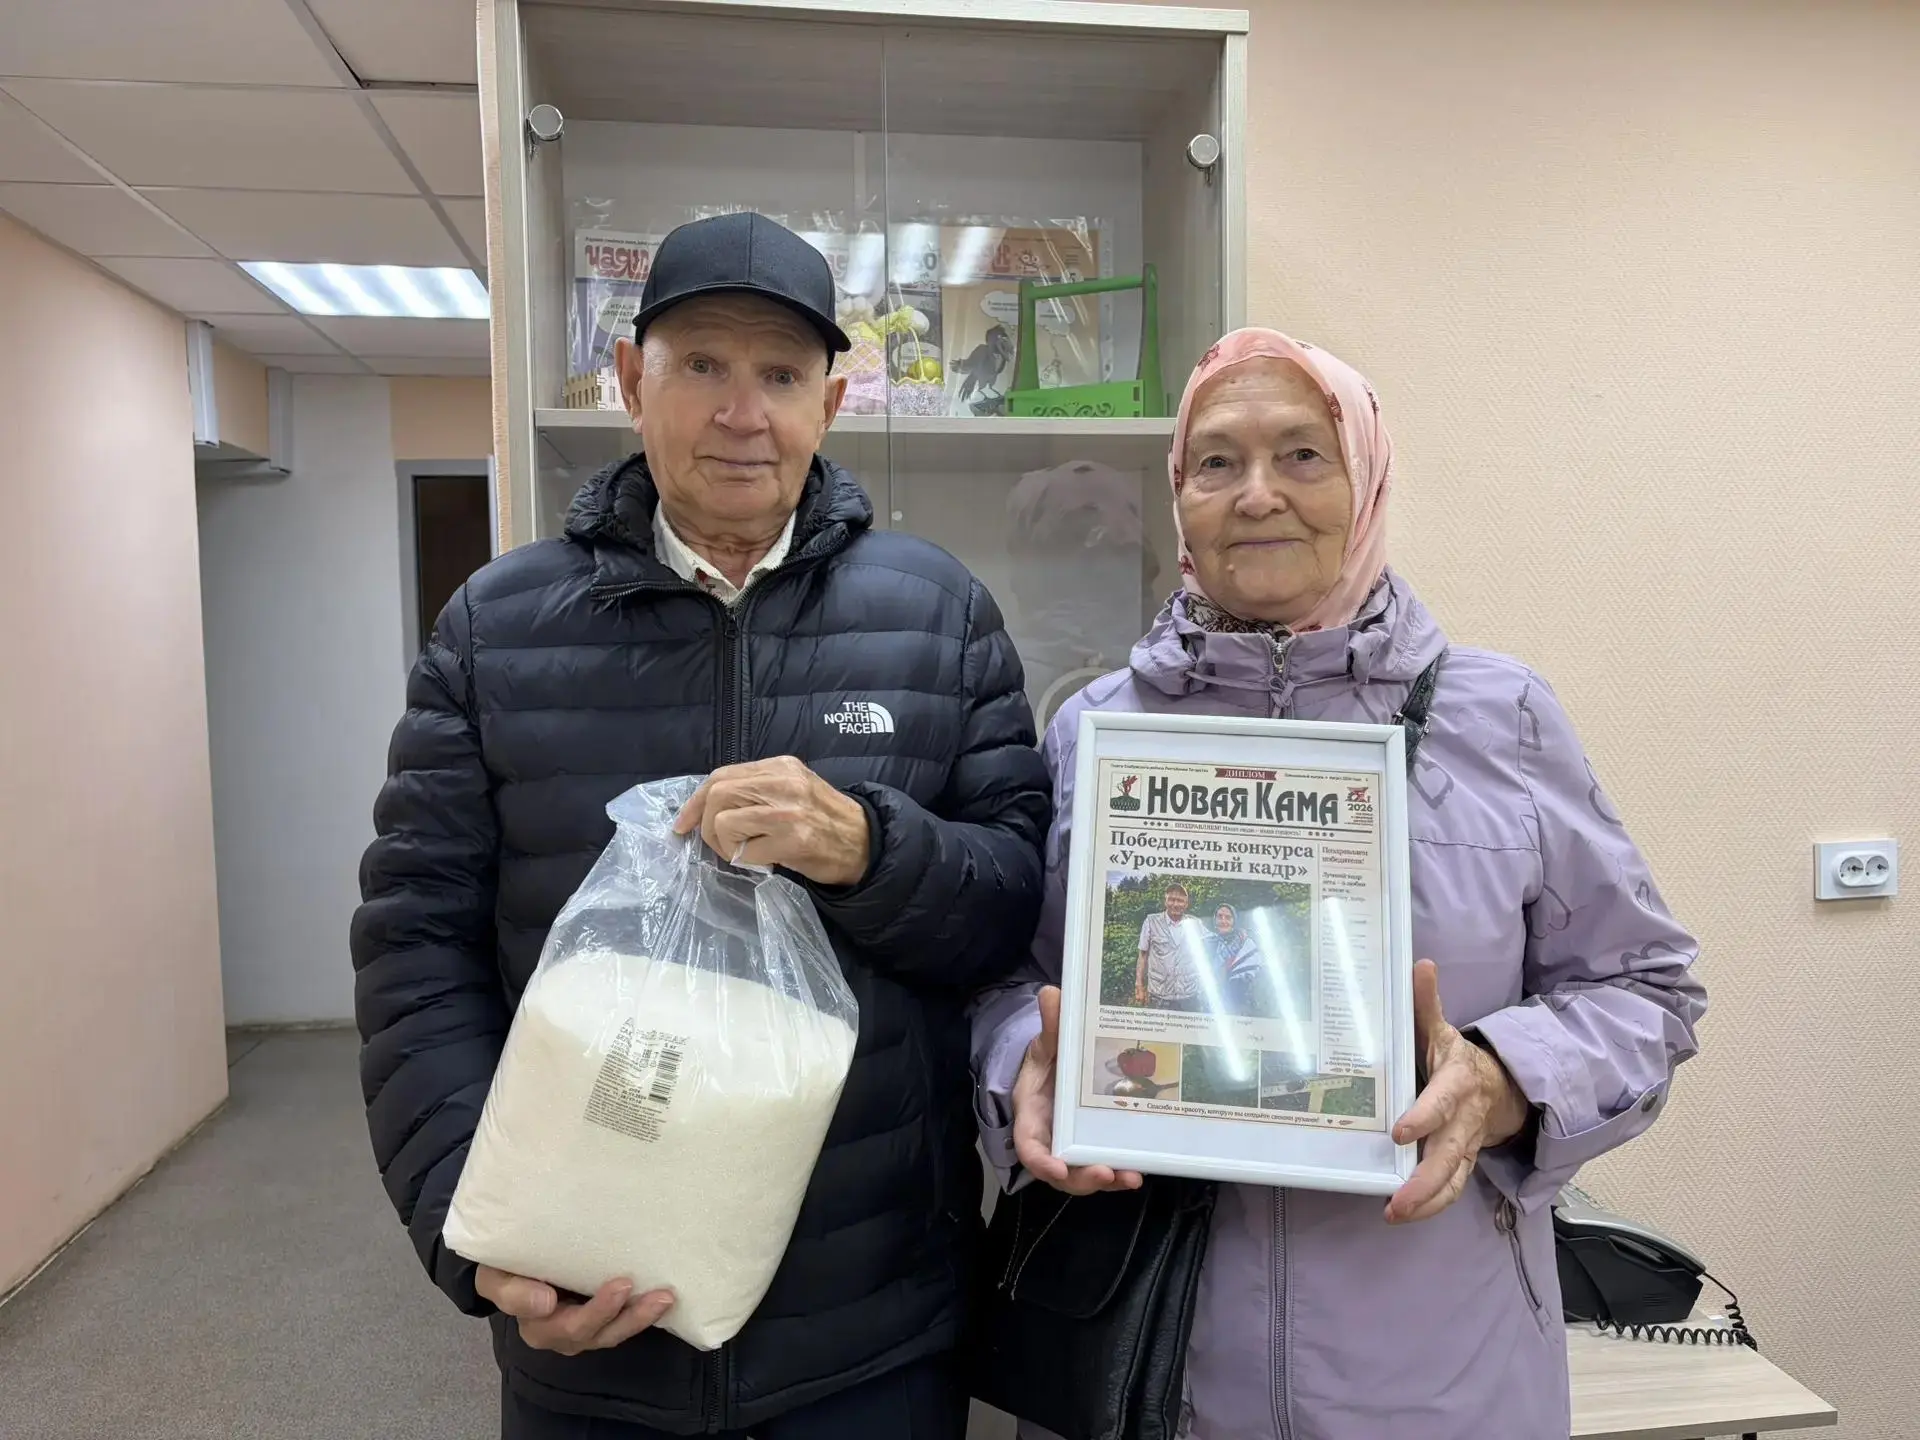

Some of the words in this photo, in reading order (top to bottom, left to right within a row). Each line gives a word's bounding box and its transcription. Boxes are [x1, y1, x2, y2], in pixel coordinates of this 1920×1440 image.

[843, 702, 868, 712] THE
[824, 712, 869, 724] NORTH
[839, 723, 871, 734] FACE
[1224, 769, 1266, 779] ДИПЛОМ
[1347, 803, 1373, 812] 2026
[1111, 830, 1223, 852] Победитель
[1227, 838, 1313, 860] конкурса
[1109, 849, 1243, 873] «Урожайный
[1248, 860, 1309, 880] кадр»
